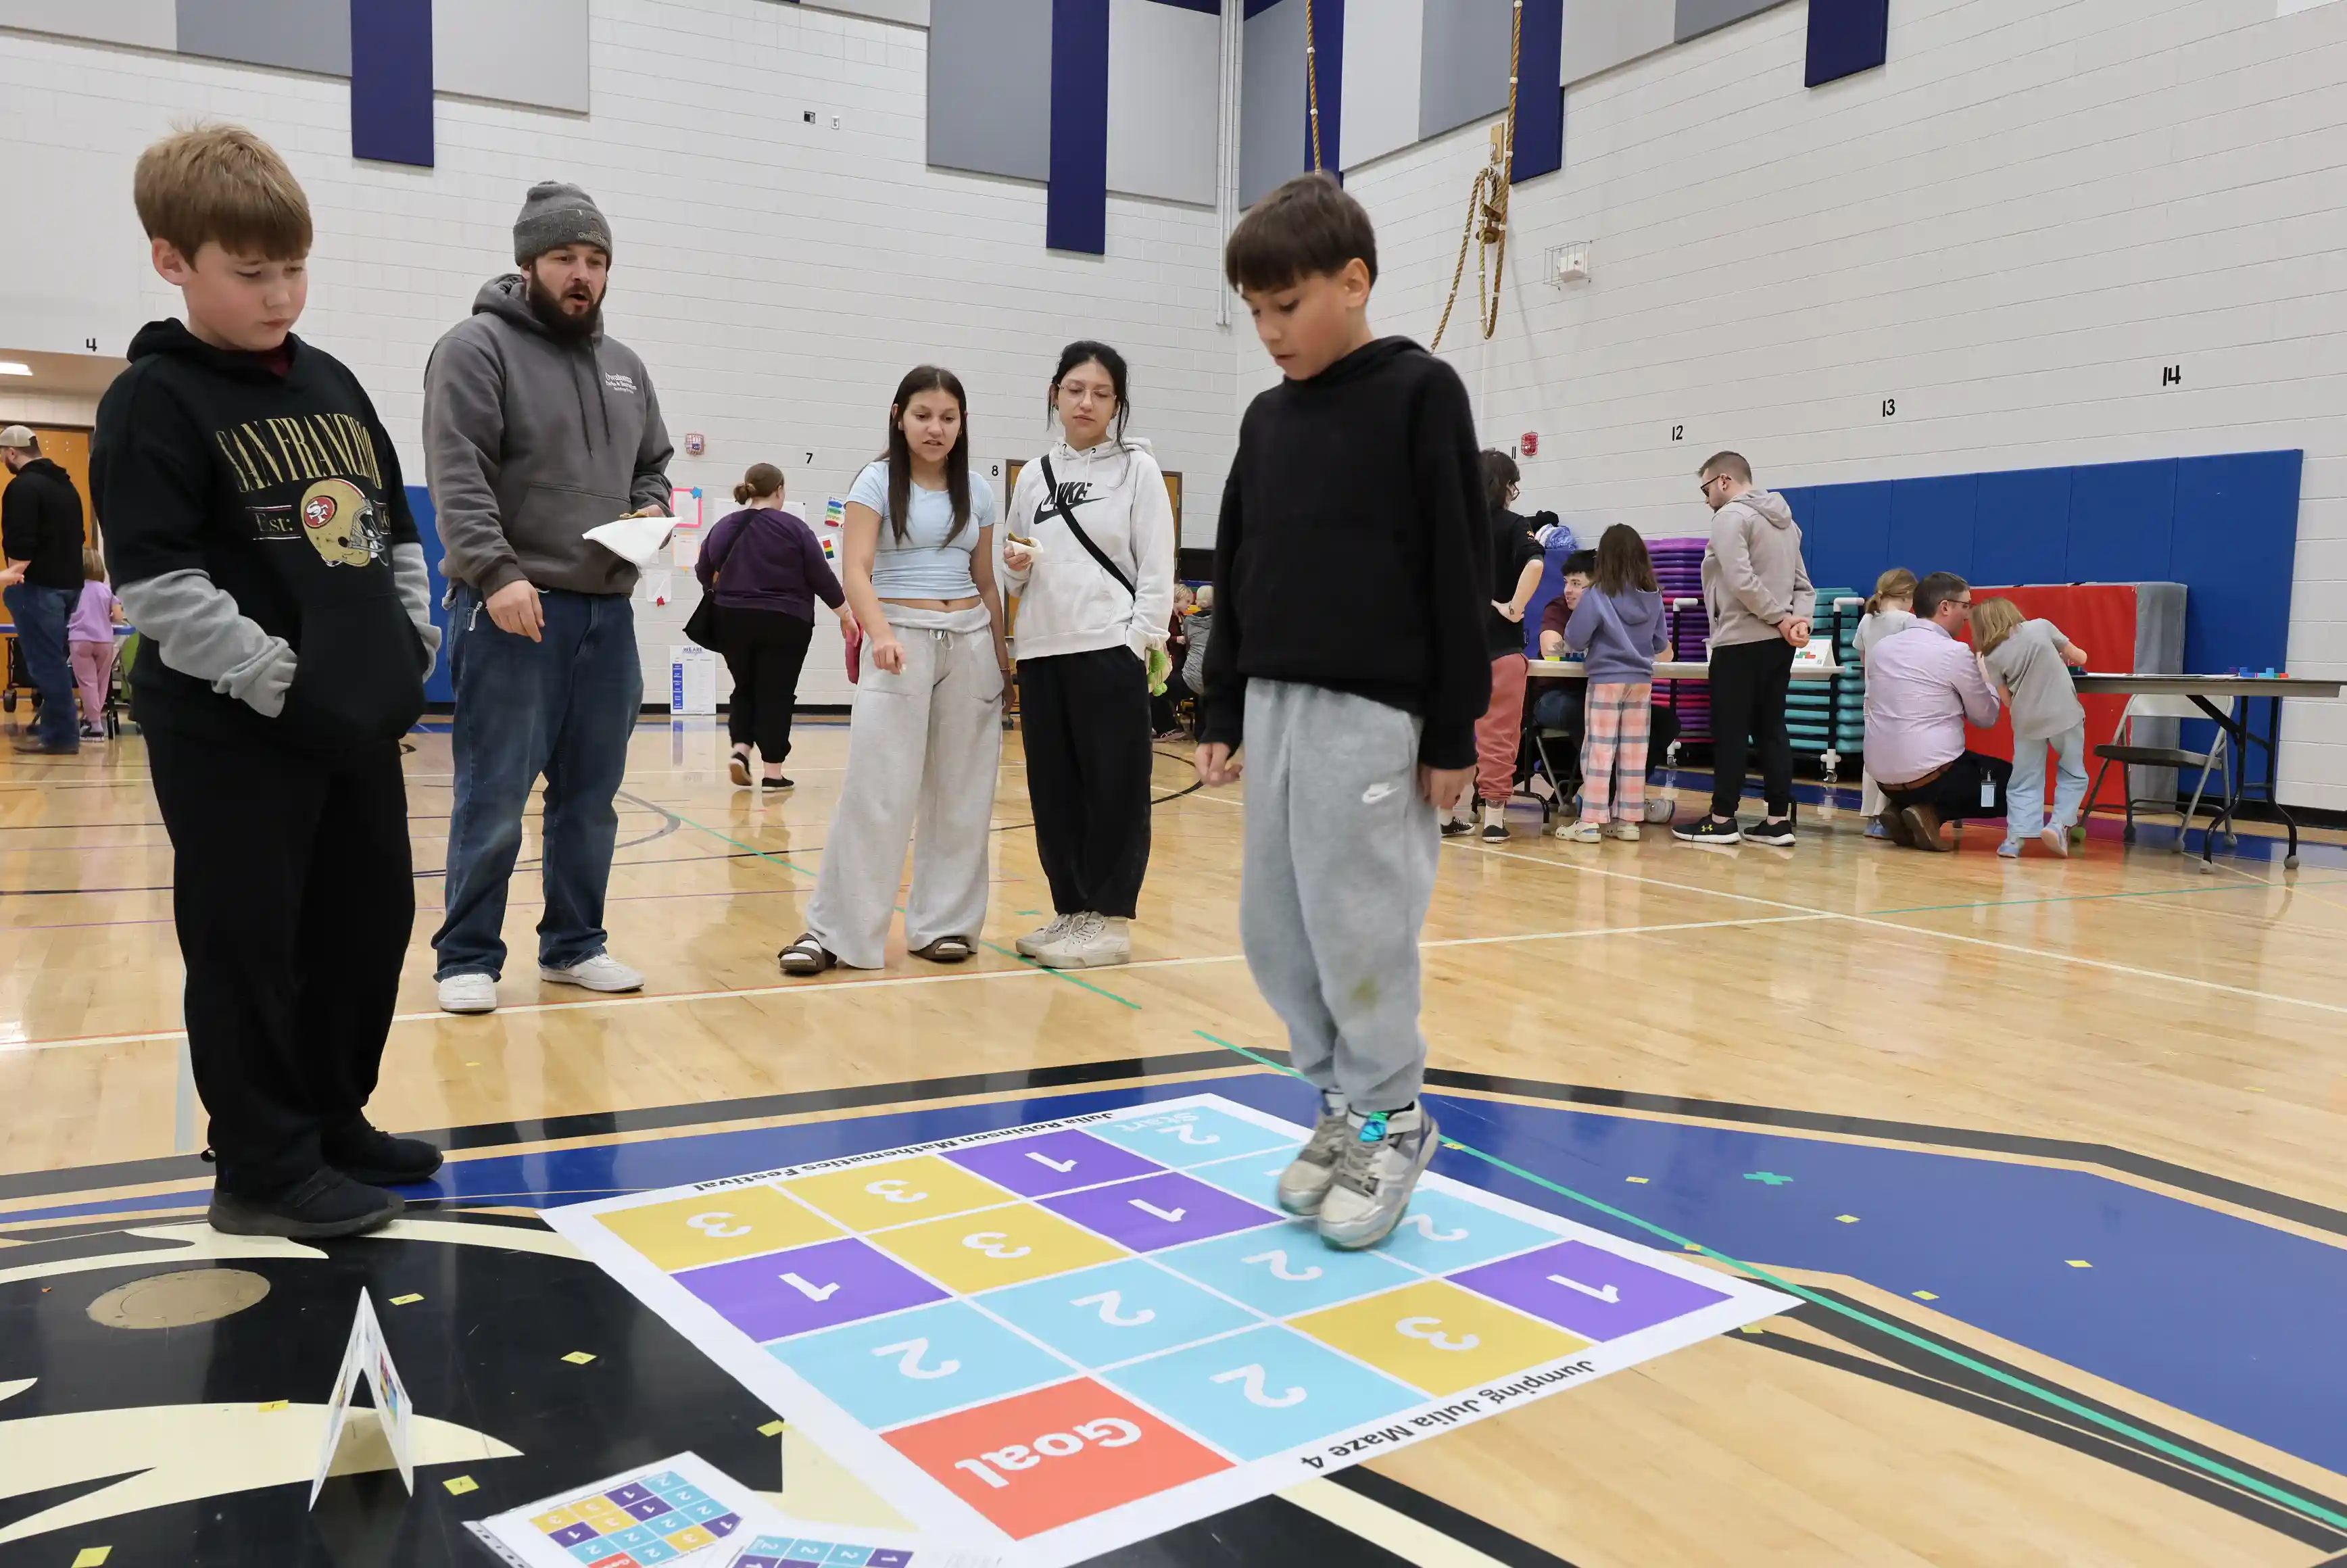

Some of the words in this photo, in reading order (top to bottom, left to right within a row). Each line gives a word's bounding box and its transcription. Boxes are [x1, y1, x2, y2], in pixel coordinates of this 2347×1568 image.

[86, 338, 97, 352] 4
[2162, 364, 2181, 387] 14
[1882, 399, 1895, 418] 13
[1672, 425, 1683, 441] 12
[216, 420, 284, 492] SAN
[266, 413, 383, 490] FRANCIO
[806, 452, 813, 464] 7
[1511, 446, 1516, 460] 11
[991, 465, 999, 476] 8
[1064, 1112, 1113, 1124] Julia
[960, 1121, 1064, 1143] Robinson
[1155, 1123, 1220, 1145] 2
[801, 1140, 959, 1171] Mathematics
[1024, 1152, 1078, 1173] 1
[692, 1168, 800, 1191] Festival
[865, 1179, 928, 1203] 3
[1128, 1199, 1186, 1223] 1
[686, 1212, 752, 1238] 3
[1399, 1213, 1470, 1242] 2
[962, 1231, 1032, 1259] 3
[1241, 1250, 1323, 1281] 2
[778, 1272, 840, 1302] 1
[1546, 1274, 1620, 1304] 1
[1069, 1290, 1155, 1327] 2
[1395, 1316, 1481, 1351] 3
[871, 1338, 960, 1379] 2
[1209, 1364, 1307, 1408] 2
[1478, 1360, 1596, 1404] Jumping
[1408, 1399, 1480, 1425] Julia
[954, 1417, 1142, 1489] Goal
[1328, 1425, 1416, 1457] Maze
[1301, 1455, 1324, 1469] 4
